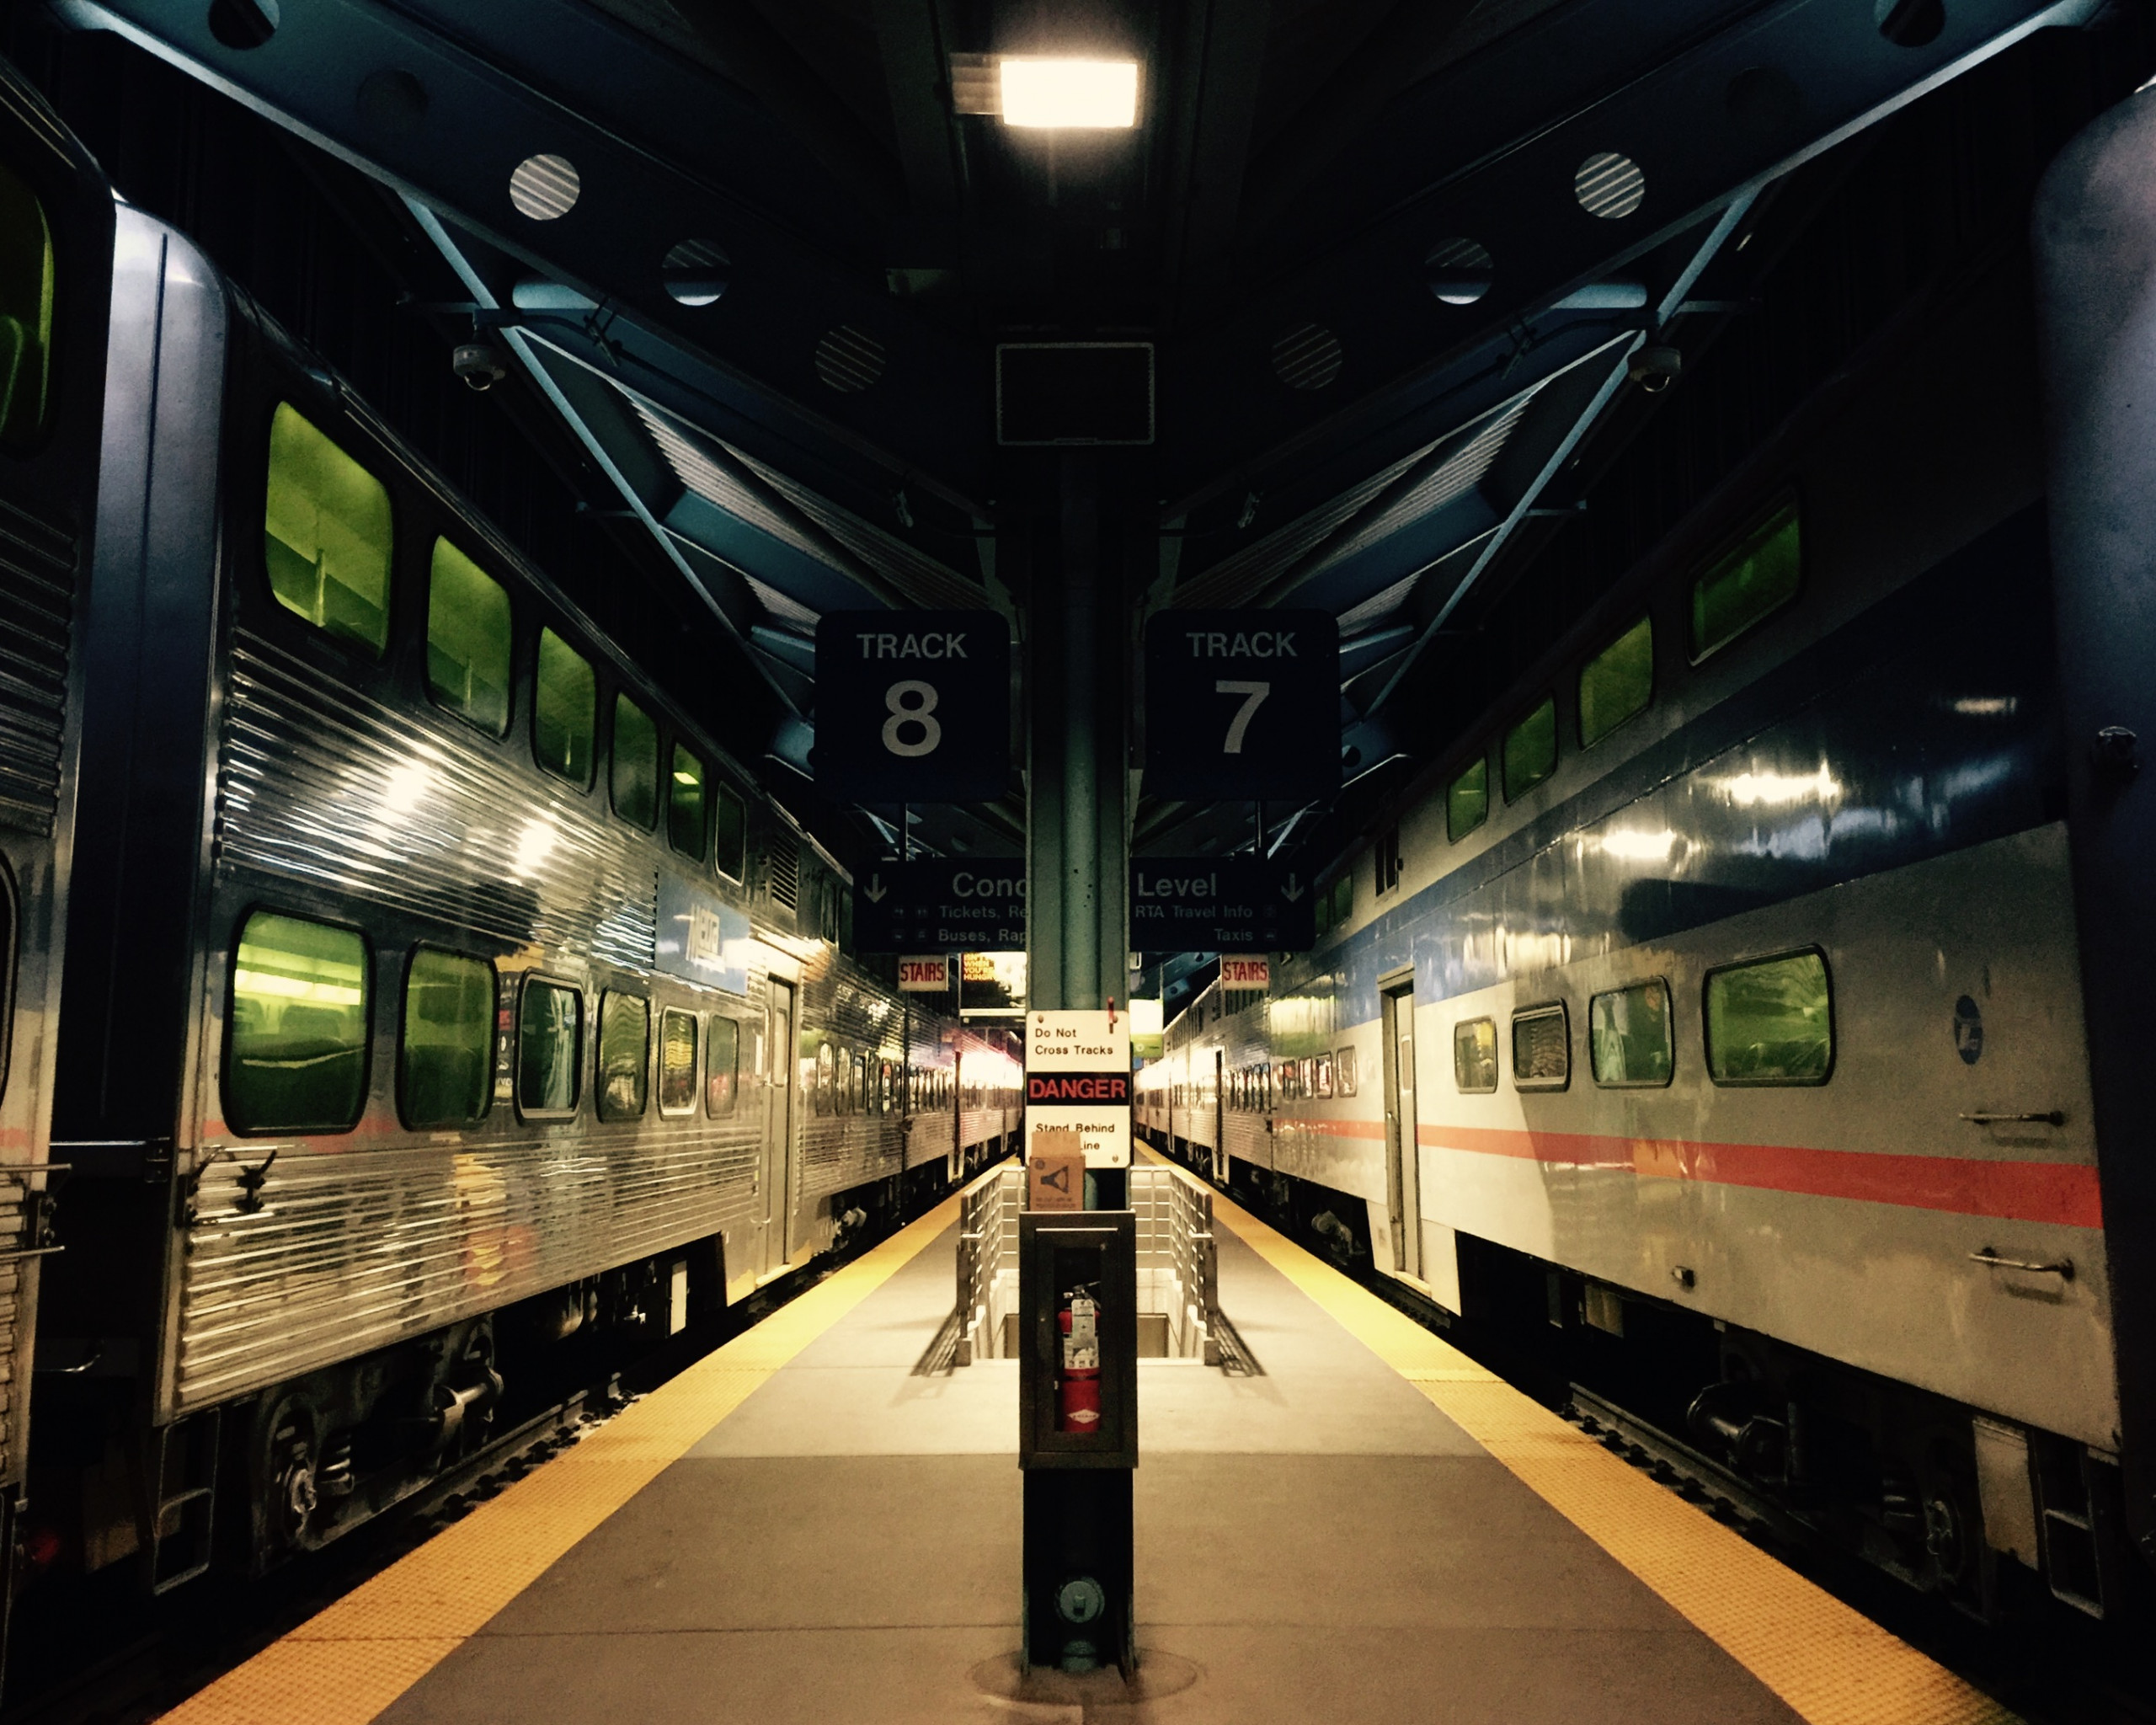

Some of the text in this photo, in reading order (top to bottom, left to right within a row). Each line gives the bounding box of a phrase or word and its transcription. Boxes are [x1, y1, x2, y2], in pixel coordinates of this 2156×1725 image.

[857, 633, 968, 659] TRACK
[1186, 632, 1298, 658] TRACK
[882, 680, 942, 756] 8
[1215, 679, 1271, 755] 7
[1138, 872, 1217, 897] Level
[938, 905, 1001, 920] Tickets,
[1135, 905, 1253, 918] RTA Travel Info
[938, 929, 990, 943] Buses,
[1214, 928, 1253, 942] Taxis
[900, 963, 945, 981] STAIRS
[1224, 962, 1267, 980] STAIRS
[1035, 1028, 1076, 1038] Do Not
[1035, 1044, 1113, 1055] Cross Tracks
[1029, 1079, 1126, 1098] DANGER
[1036, 1123, 1115, 1133] Stand Behind
